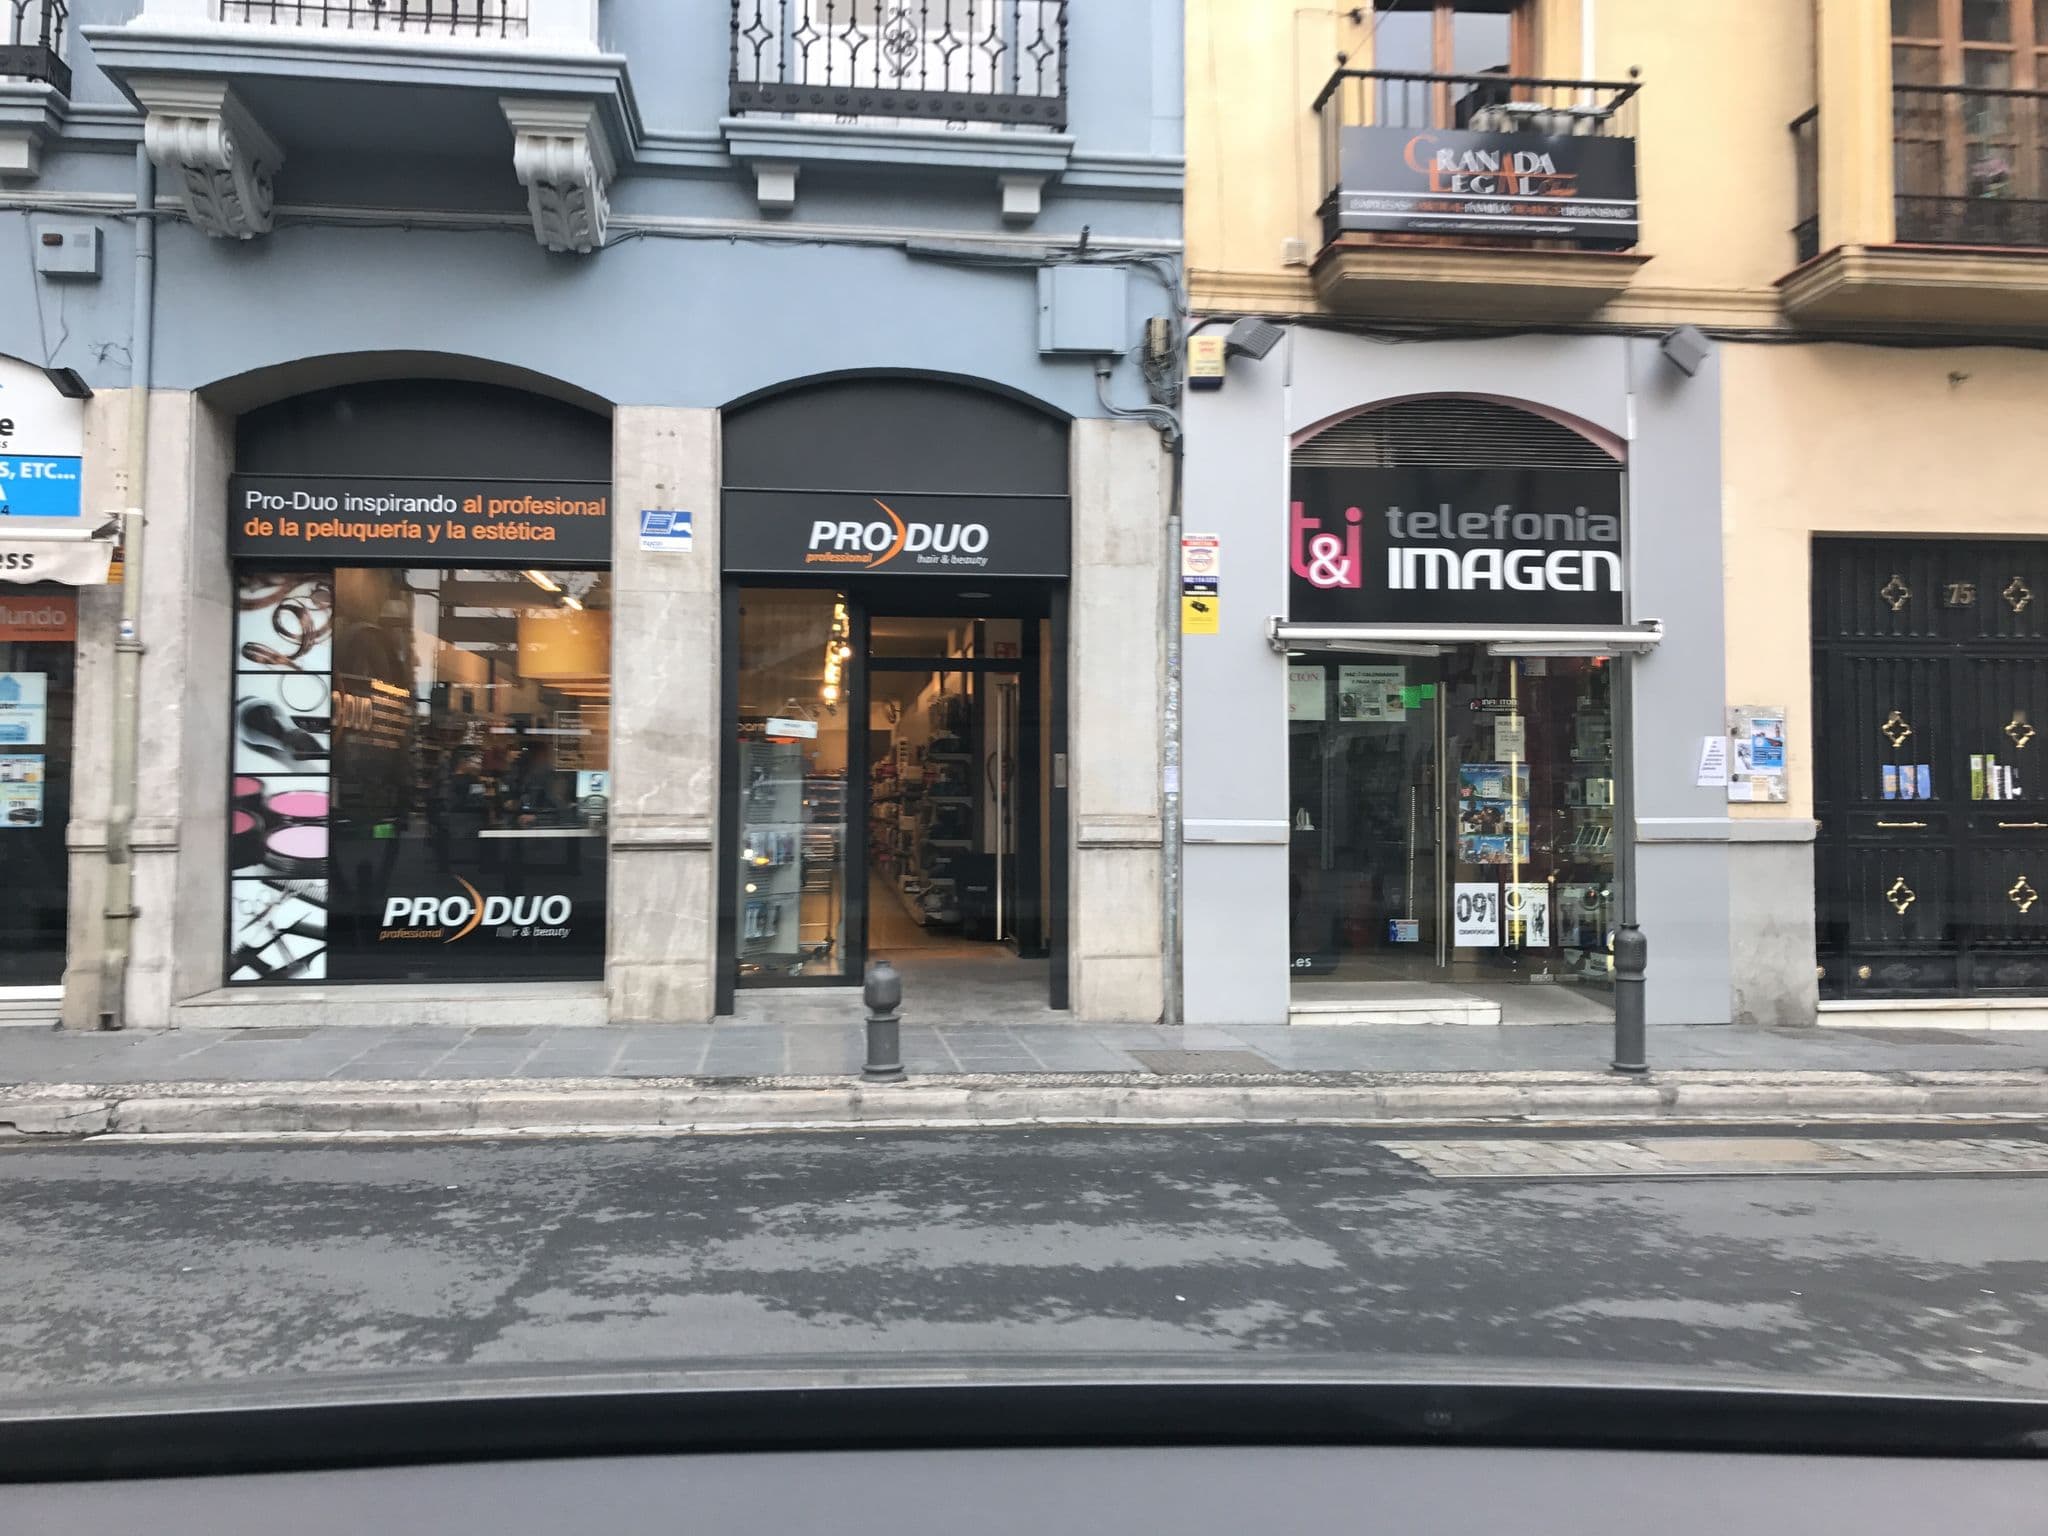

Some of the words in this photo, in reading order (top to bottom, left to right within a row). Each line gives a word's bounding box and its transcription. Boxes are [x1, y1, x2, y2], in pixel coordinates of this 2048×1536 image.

[20, 463, 76, 480] ETC...
[245, 490, 338, 511] Pro-Duo
[344, 492, 457, 516] inspirando
[463, 494, 482, 514] al
[488, 495, 607, 519] profesional
[244, 519, 273, 537] de
[278, 518, 298, 537] la
[305, 519, 421, 541] peluquería
[428, 525, 442, 543] y
[446, 520, 466, 539] la
[472, 521, 556, 541] estética
[1385, 503, 1618, 541] telefonia
[805, 552, 873, 564] professional
[916, 554, 939, 564] hair
[950, 555, 988, 567] beauty
[1457, 892, 1496, 923] 091
[379, 927, 442, 940] professional
[520, 927, 531, 938] &
[532, 927, 572, 939] beauty
